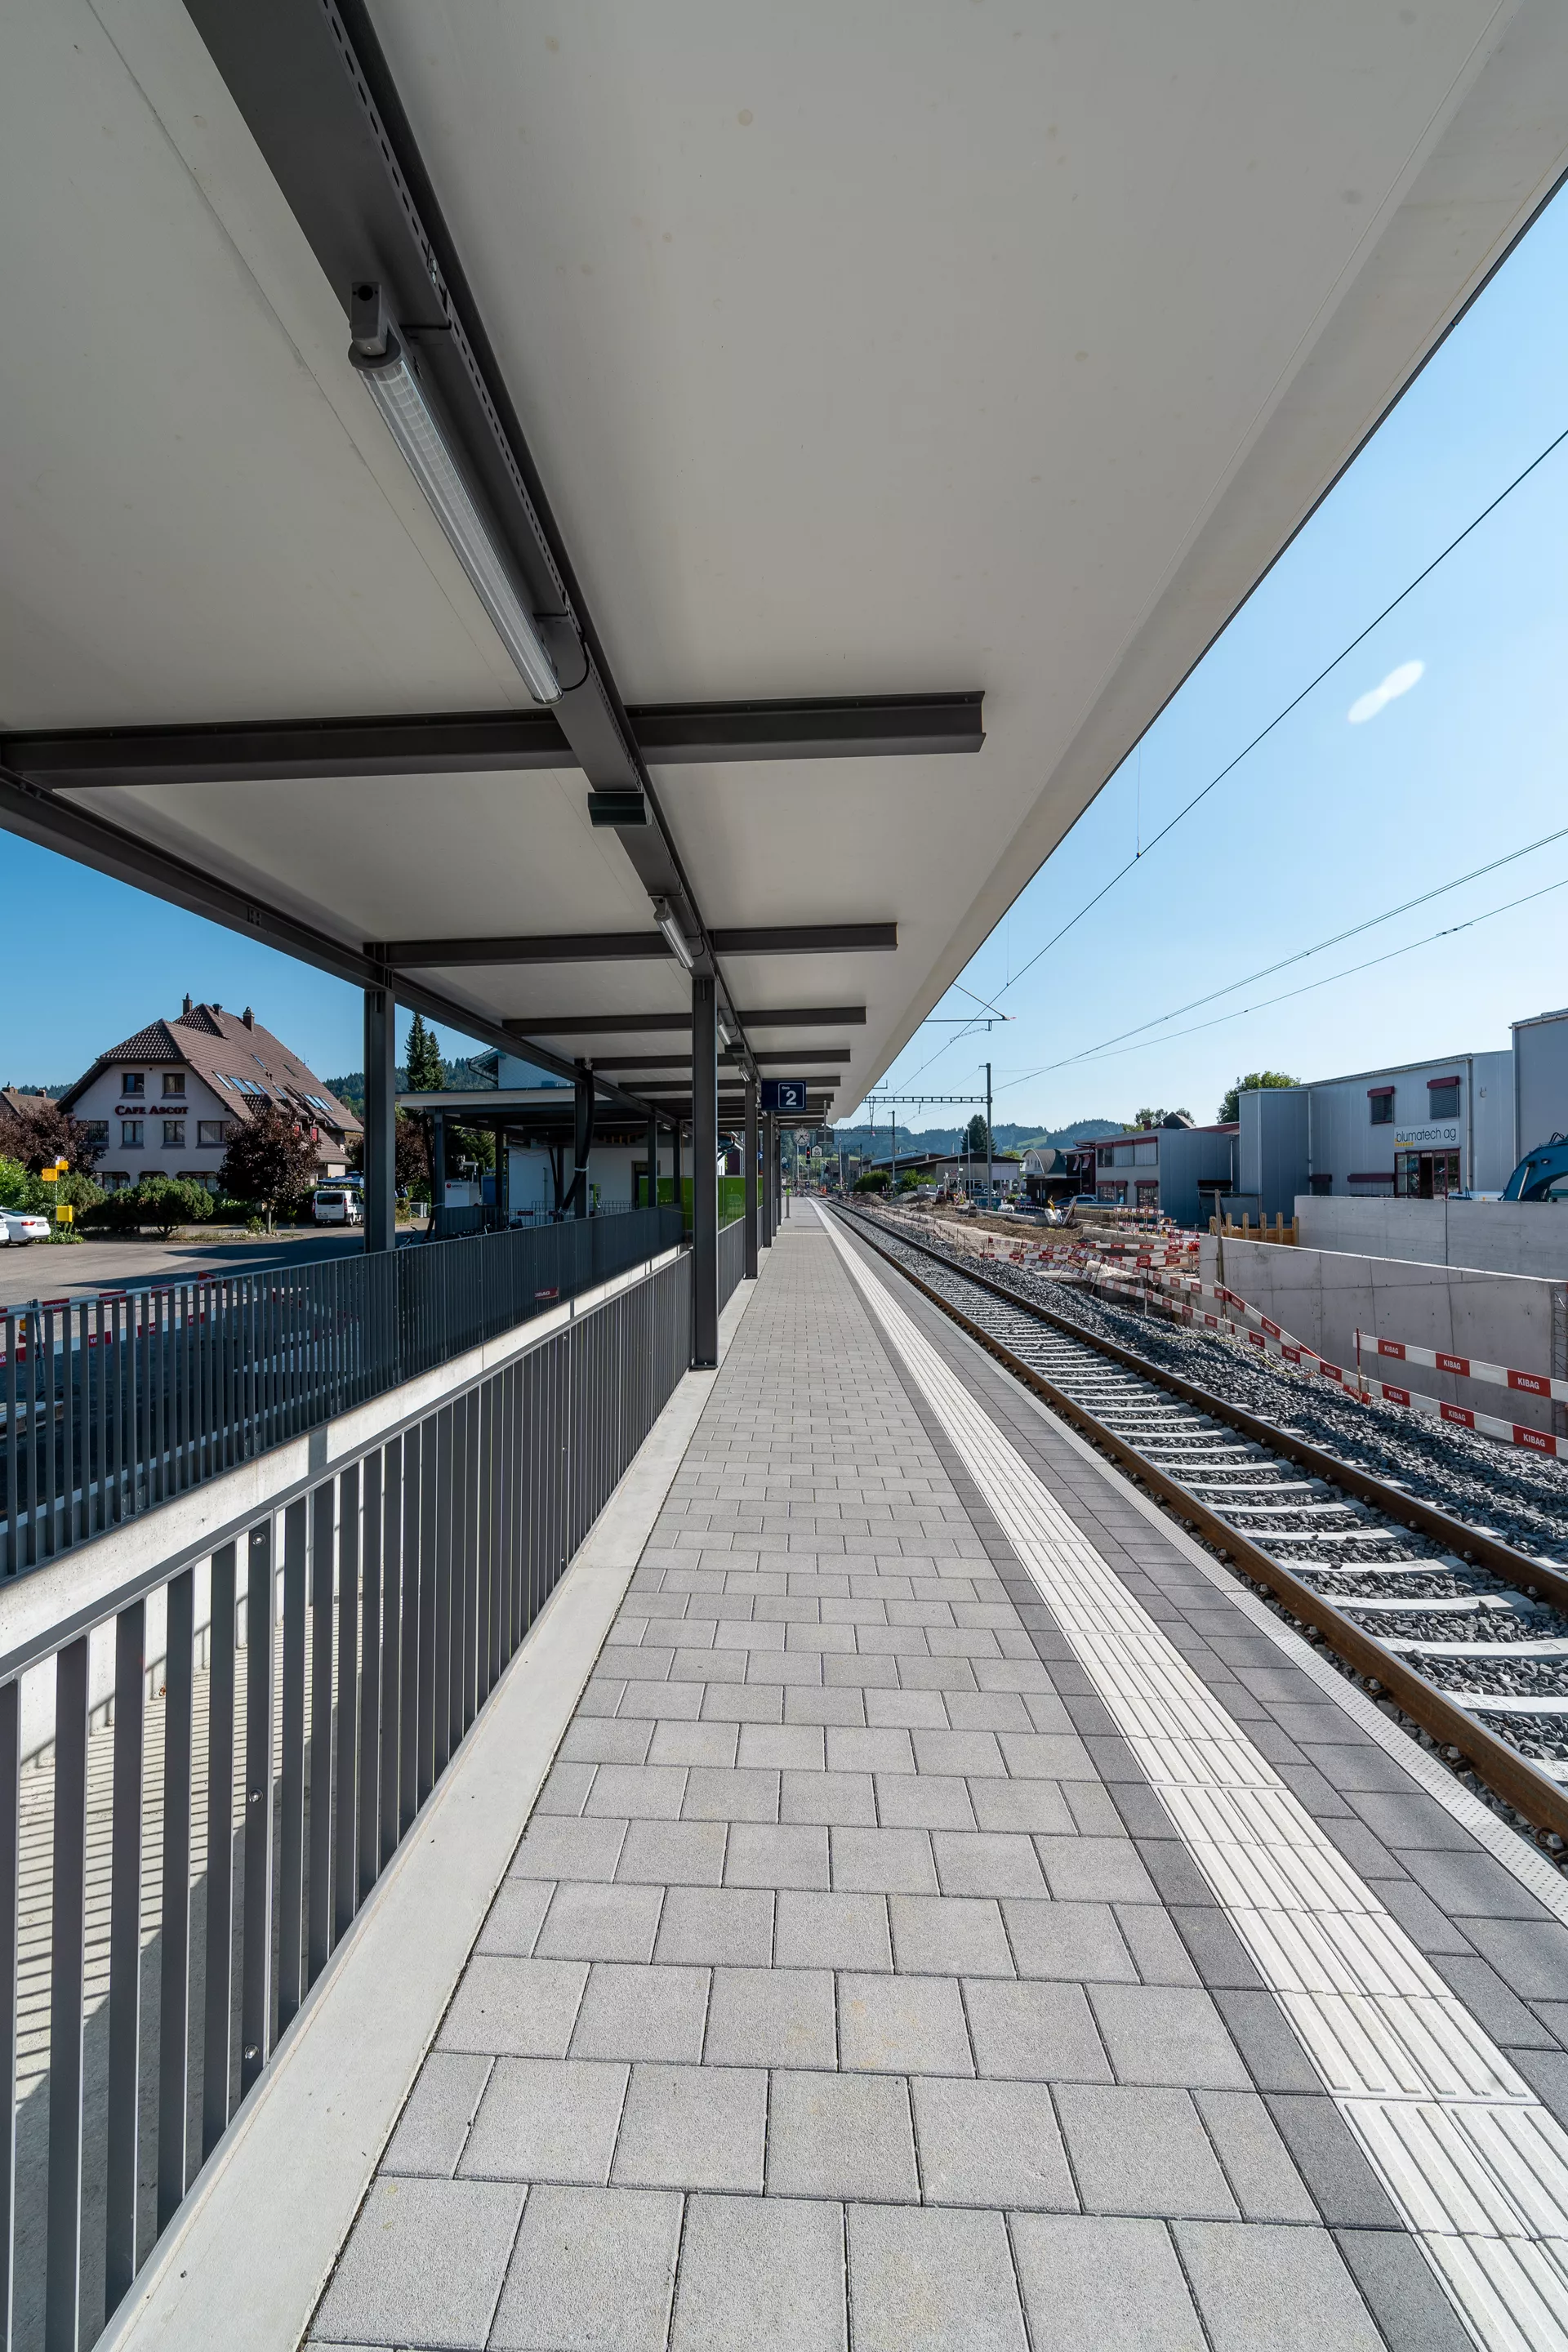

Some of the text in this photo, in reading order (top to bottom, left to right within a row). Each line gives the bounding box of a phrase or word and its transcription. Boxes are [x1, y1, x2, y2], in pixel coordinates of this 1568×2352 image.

[786, 1090, 797, 1106] 2
[149, 1105, 189, 1115] ASCOT
[1396, 1128, 1457, 1143] blumatech ag
[1384, 1344, 1399, 1355] KIBAG
[1443, 1359, 1461, 1370] KIBAG
[1517, 1377, 1539, 1390] KIBAG
[1388, 1390, 1403, 1401] KIBAG
[1448, 1410, 1467, 1422] KIBAG
[1523, 1433, 1545, 1448] KIBAG
